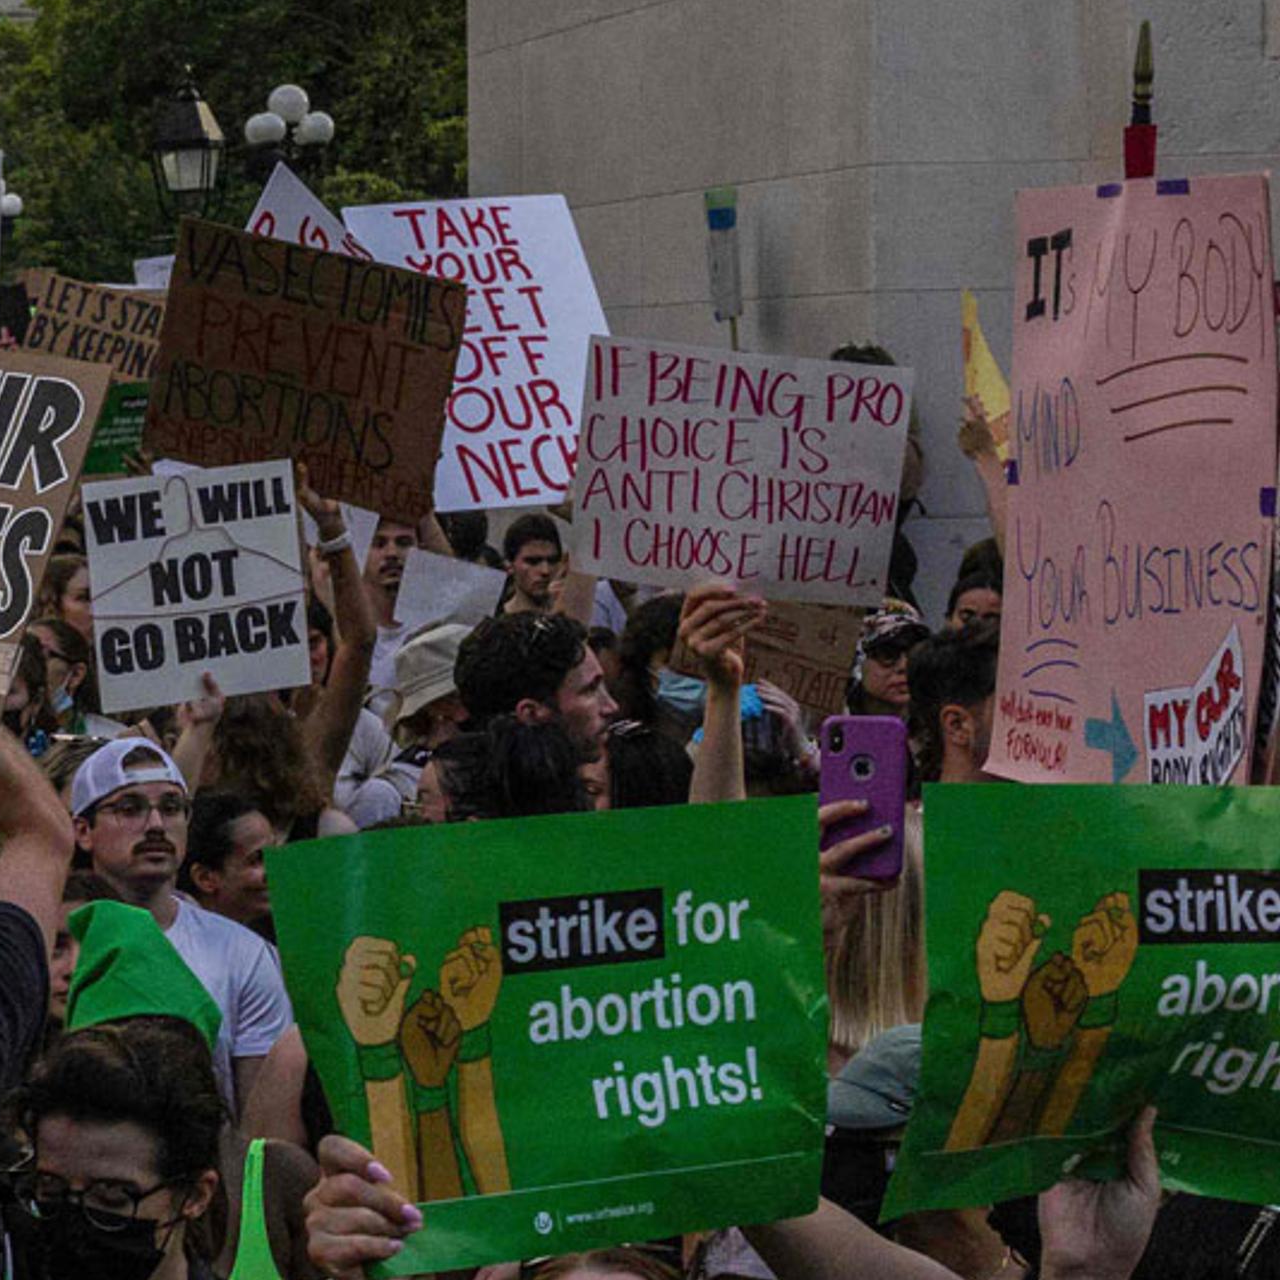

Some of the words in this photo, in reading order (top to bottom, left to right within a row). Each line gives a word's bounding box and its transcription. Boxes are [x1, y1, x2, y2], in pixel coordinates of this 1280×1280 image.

[393, 206, 519, 250] TAKE
[188, 226, 458, 352] VASECTOMIES
[1172, 212, 1266, 360] BODY
[197, 293, 424, 411] PREVENT
[453, 335, 548, 382] OFF
[162, 359, 393, 470] ABORTIONS
[448, 378, 572, 433] OUR
[594, 344, 638, 402] IF
[648, 351, 816, 433] BEING
[826, 373, 904, 426] PRO
[587, 414, 760, 472] CHOICE
[781, 426, 829, 474] IS
[86, 491, 166, 546] WE
[197, 477, 291, 524] WILL
[582, 468, 701, 513] ANTI
[717, 470, 896, 528] CHRISTIAN
[149, 549, 238, 607] NOT
[592, 517, 601, 560] I
[624, 519, 762, 581] CHOOSE
[779, 533, 878, 588] HELL.
[100, 623, 166, 675] GO
[173, 600, 301, 664] BACK
[1149, 699, 1189, 751] MY
[506, 897, 658, 964] strike
[672, 890, 750, 947] for
[1145, 874, 1280, 933] strike
[528, 974, 756, 1045] abortion
[592, 1046, 763, 1128] rights!
